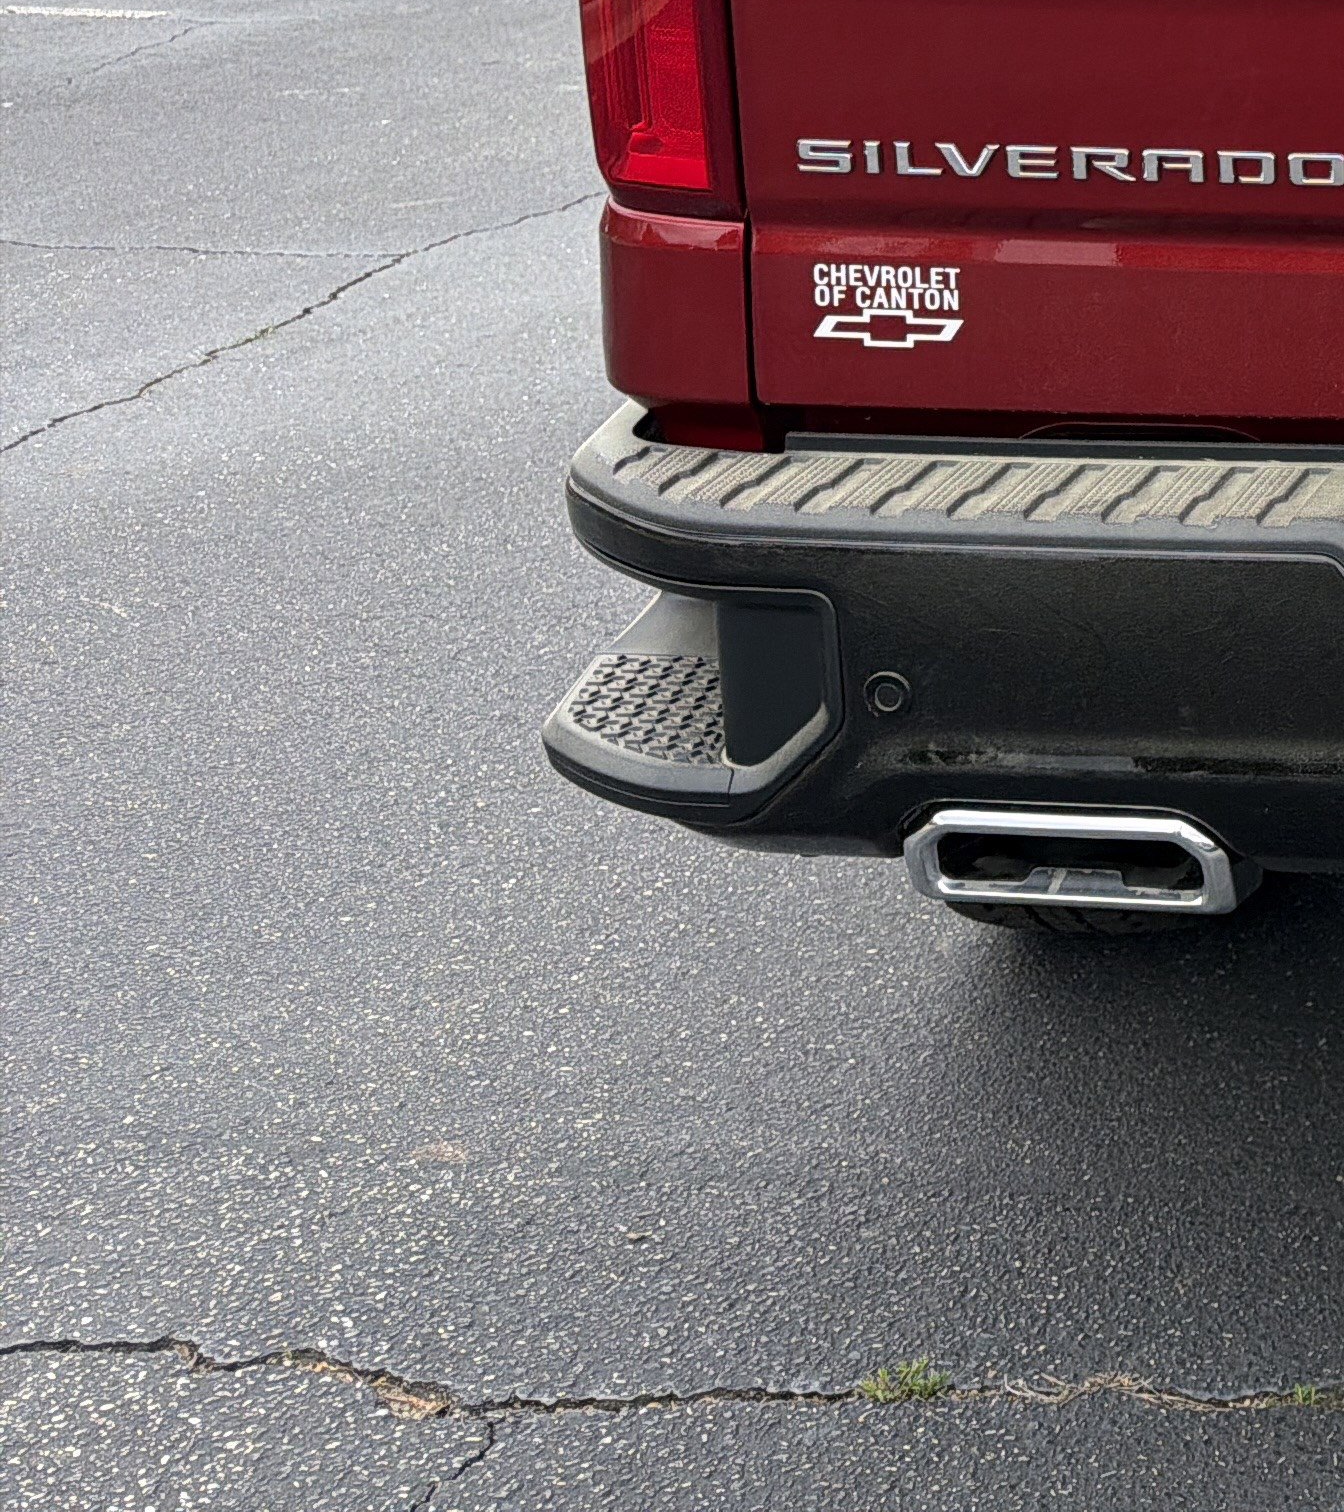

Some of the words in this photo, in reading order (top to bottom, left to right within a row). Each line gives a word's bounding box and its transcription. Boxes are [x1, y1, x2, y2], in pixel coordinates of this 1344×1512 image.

[813, 263, 960, 289] CHEVROLET
[814, 285, 847, 307] OF
[855, 287, 959, 311] CANTON
